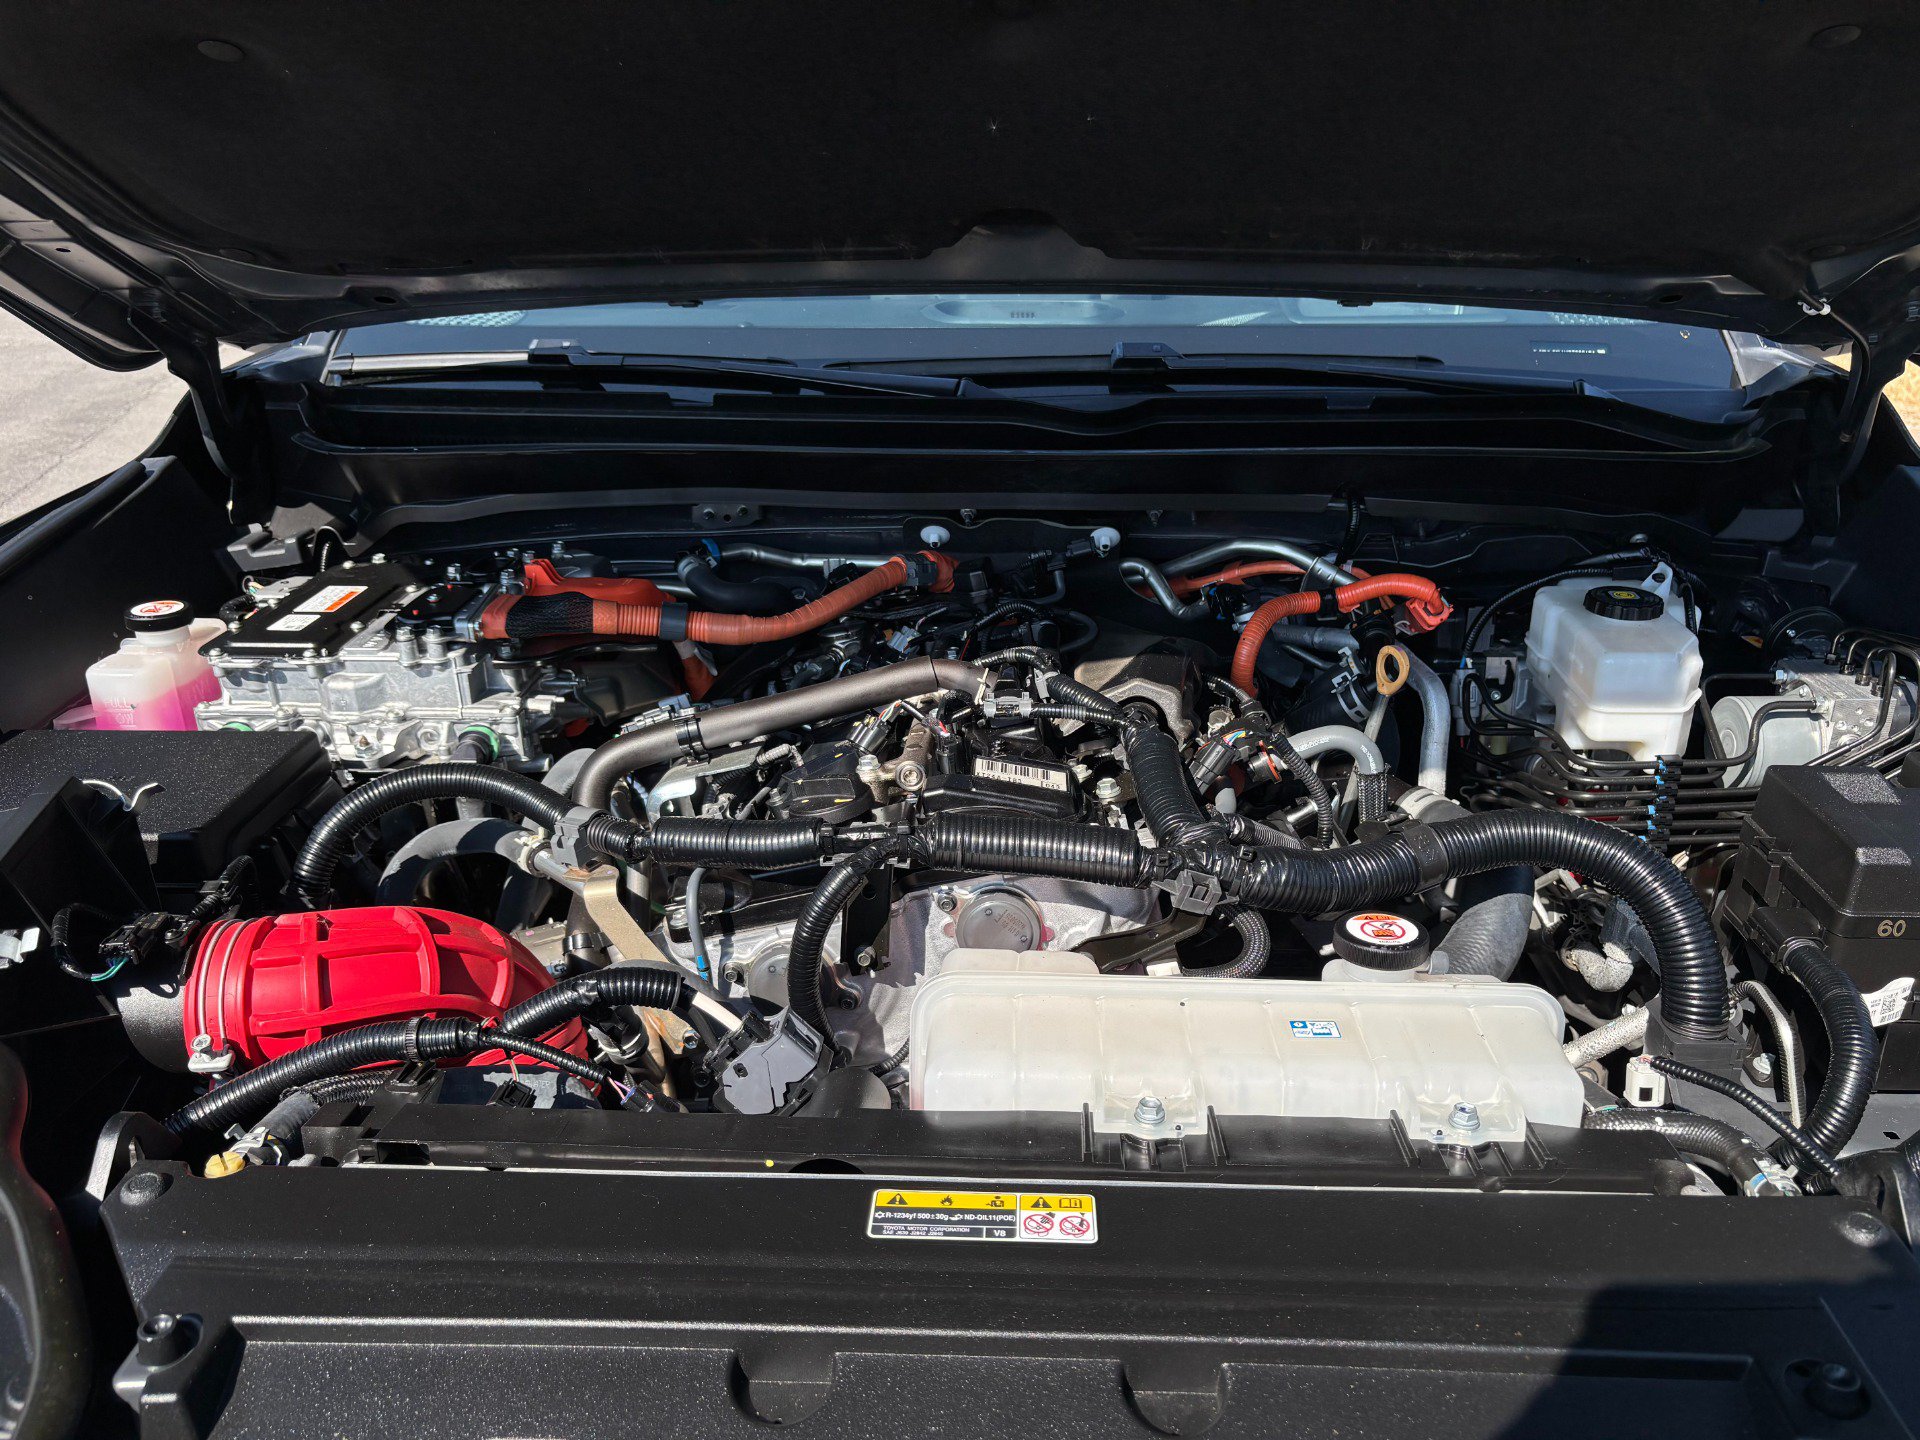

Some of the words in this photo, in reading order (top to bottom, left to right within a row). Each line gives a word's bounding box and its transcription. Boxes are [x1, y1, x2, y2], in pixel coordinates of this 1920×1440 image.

[1877, 919, 1906, 937] 60
[885, 1211, 916, 1220] R-1234yf
[917, 1213, 949, 1221] 500±30g
[964, 1213, 1016, 1222] ND-OIL11(POE)
[993, 1229, 1007, 1237] V8
